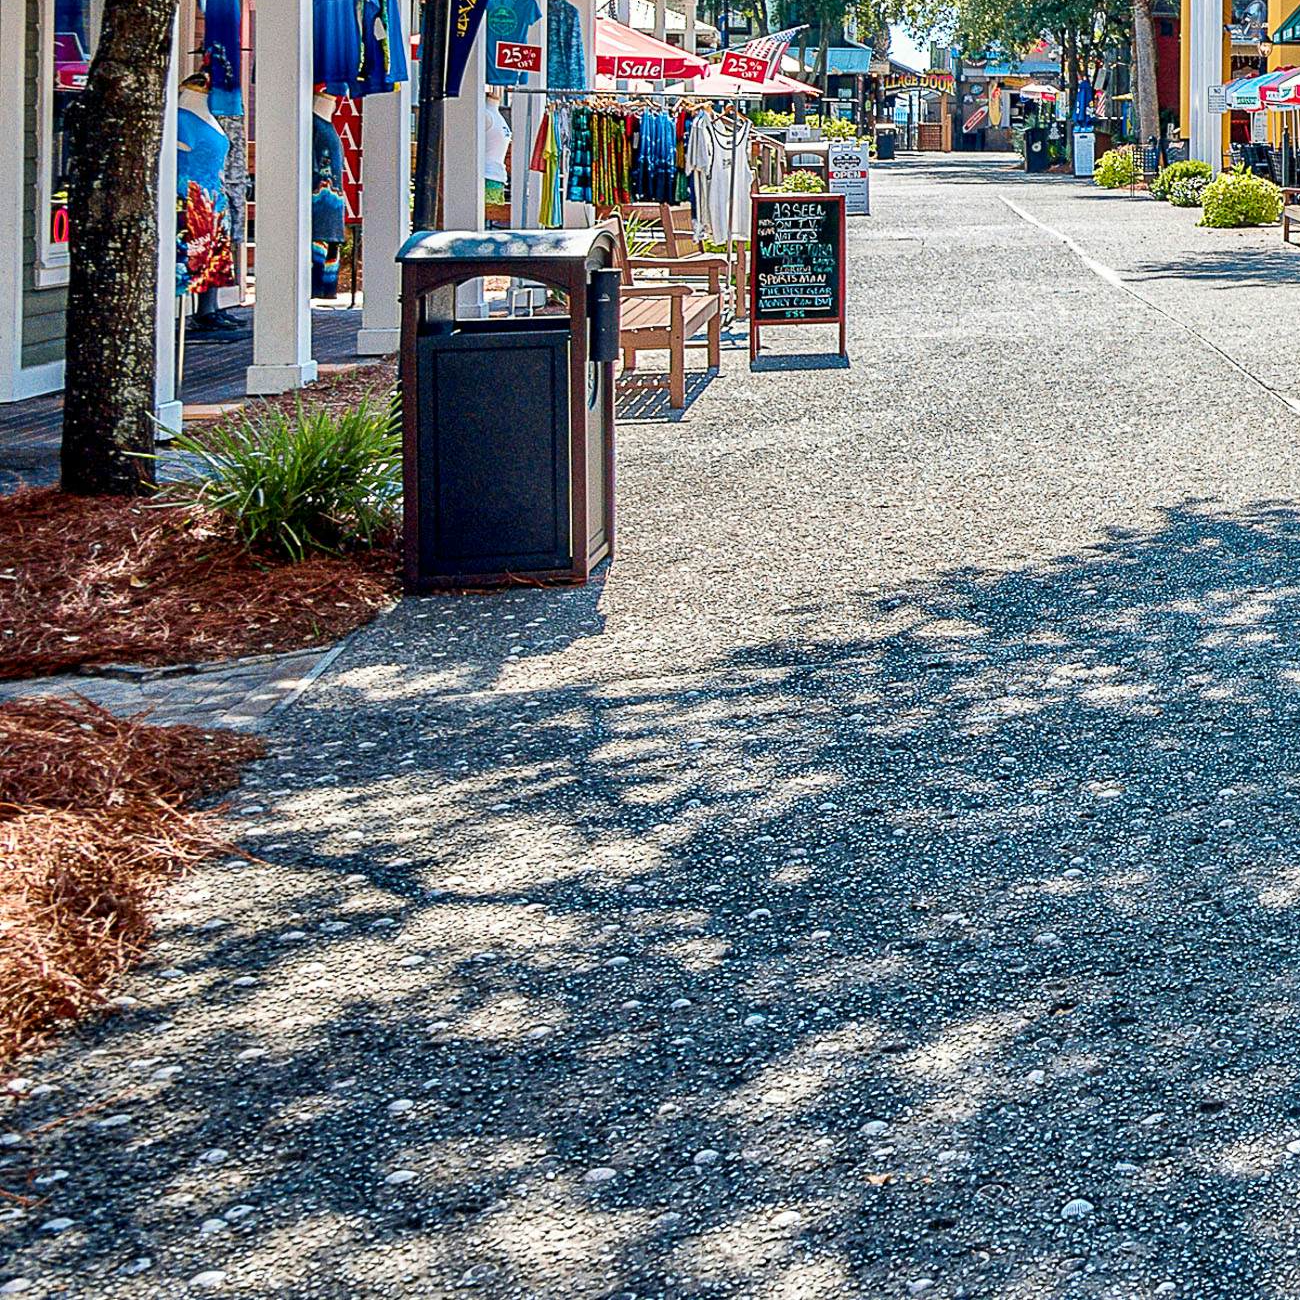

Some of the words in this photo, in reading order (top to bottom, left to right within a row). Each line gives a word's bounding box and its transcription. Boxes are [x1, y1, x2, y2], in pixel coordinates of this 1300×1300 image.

[517, 59, 534, 69] OFF
[618, 61, 661, 77] Sale
[741, 70, 760, 78] OFF
[920, 74, 956, 96] DOOR
[833, 171, 861, 179] OPEN
[760, 241, 803, 257] WICKED
